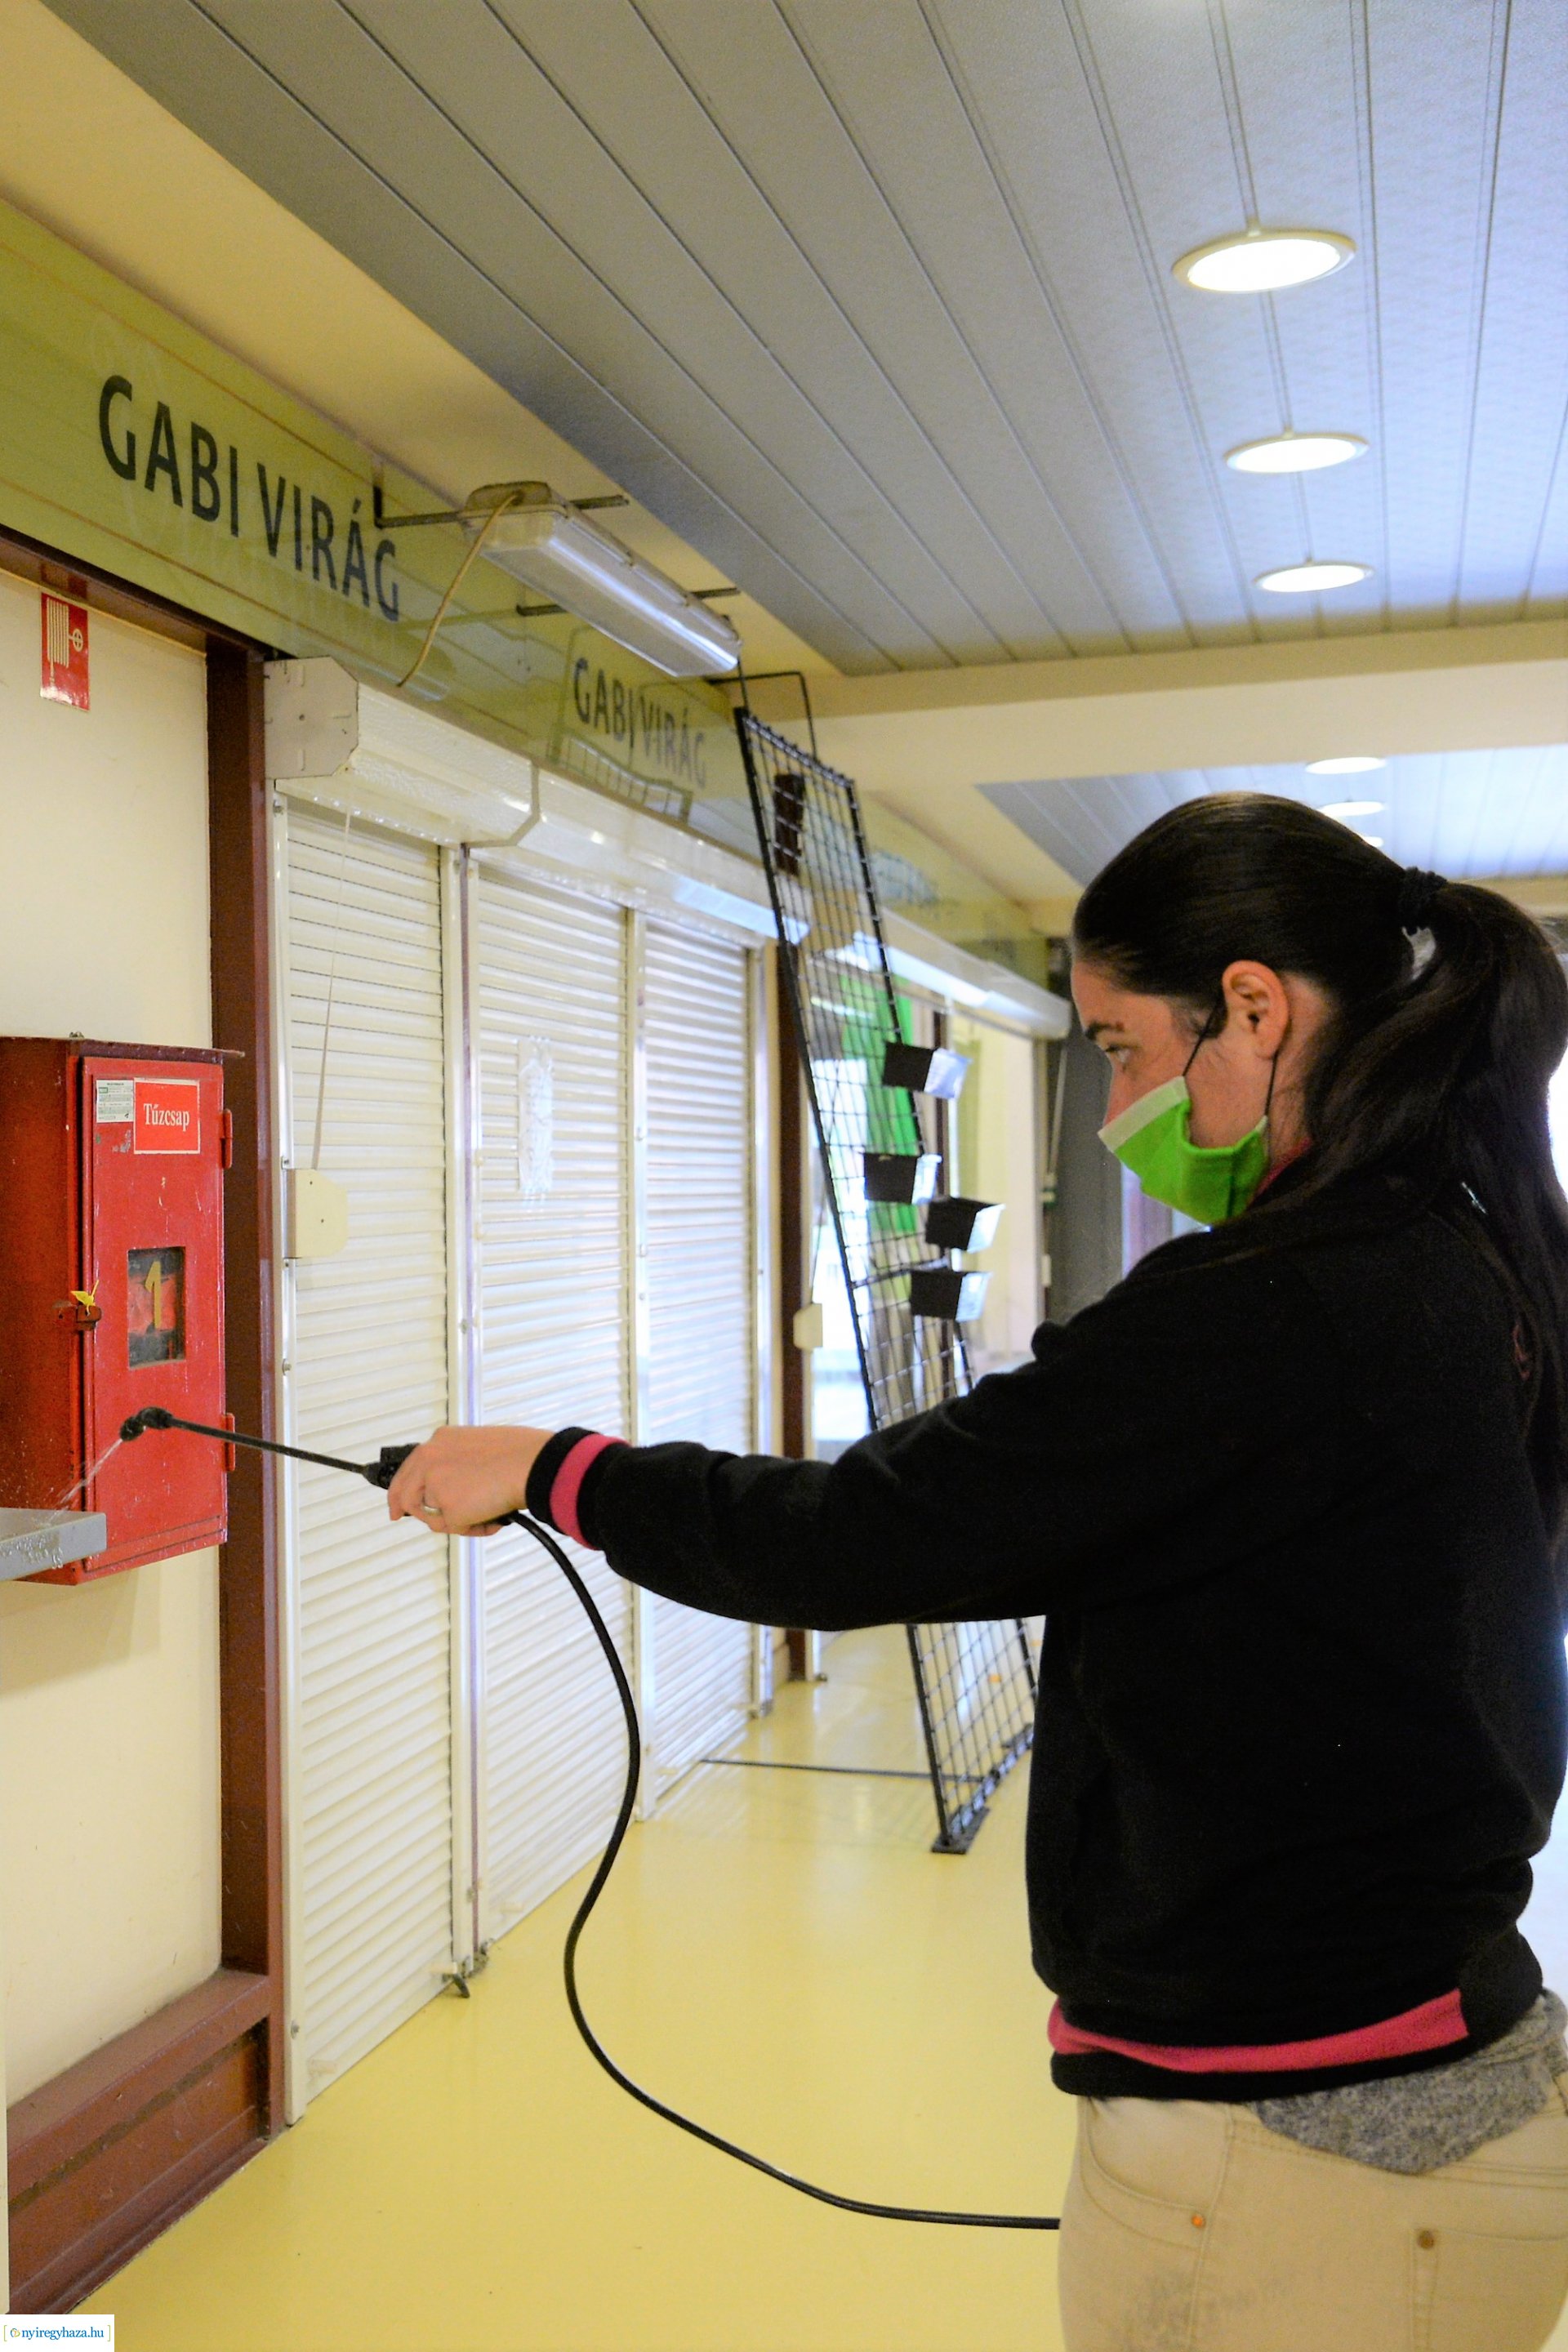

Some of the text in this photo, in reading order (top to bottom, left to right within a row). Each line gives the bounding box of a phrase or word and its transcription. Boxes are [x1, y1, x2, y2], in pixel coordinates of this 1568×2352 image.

[99, 374, 399, 623] GABI VIRÁG
[573, 657, 706, 790] GABI VIRÁG
[143, 1102, 190, 1133] Tűzcsap
[145, 1260, 162, 1330] 1
